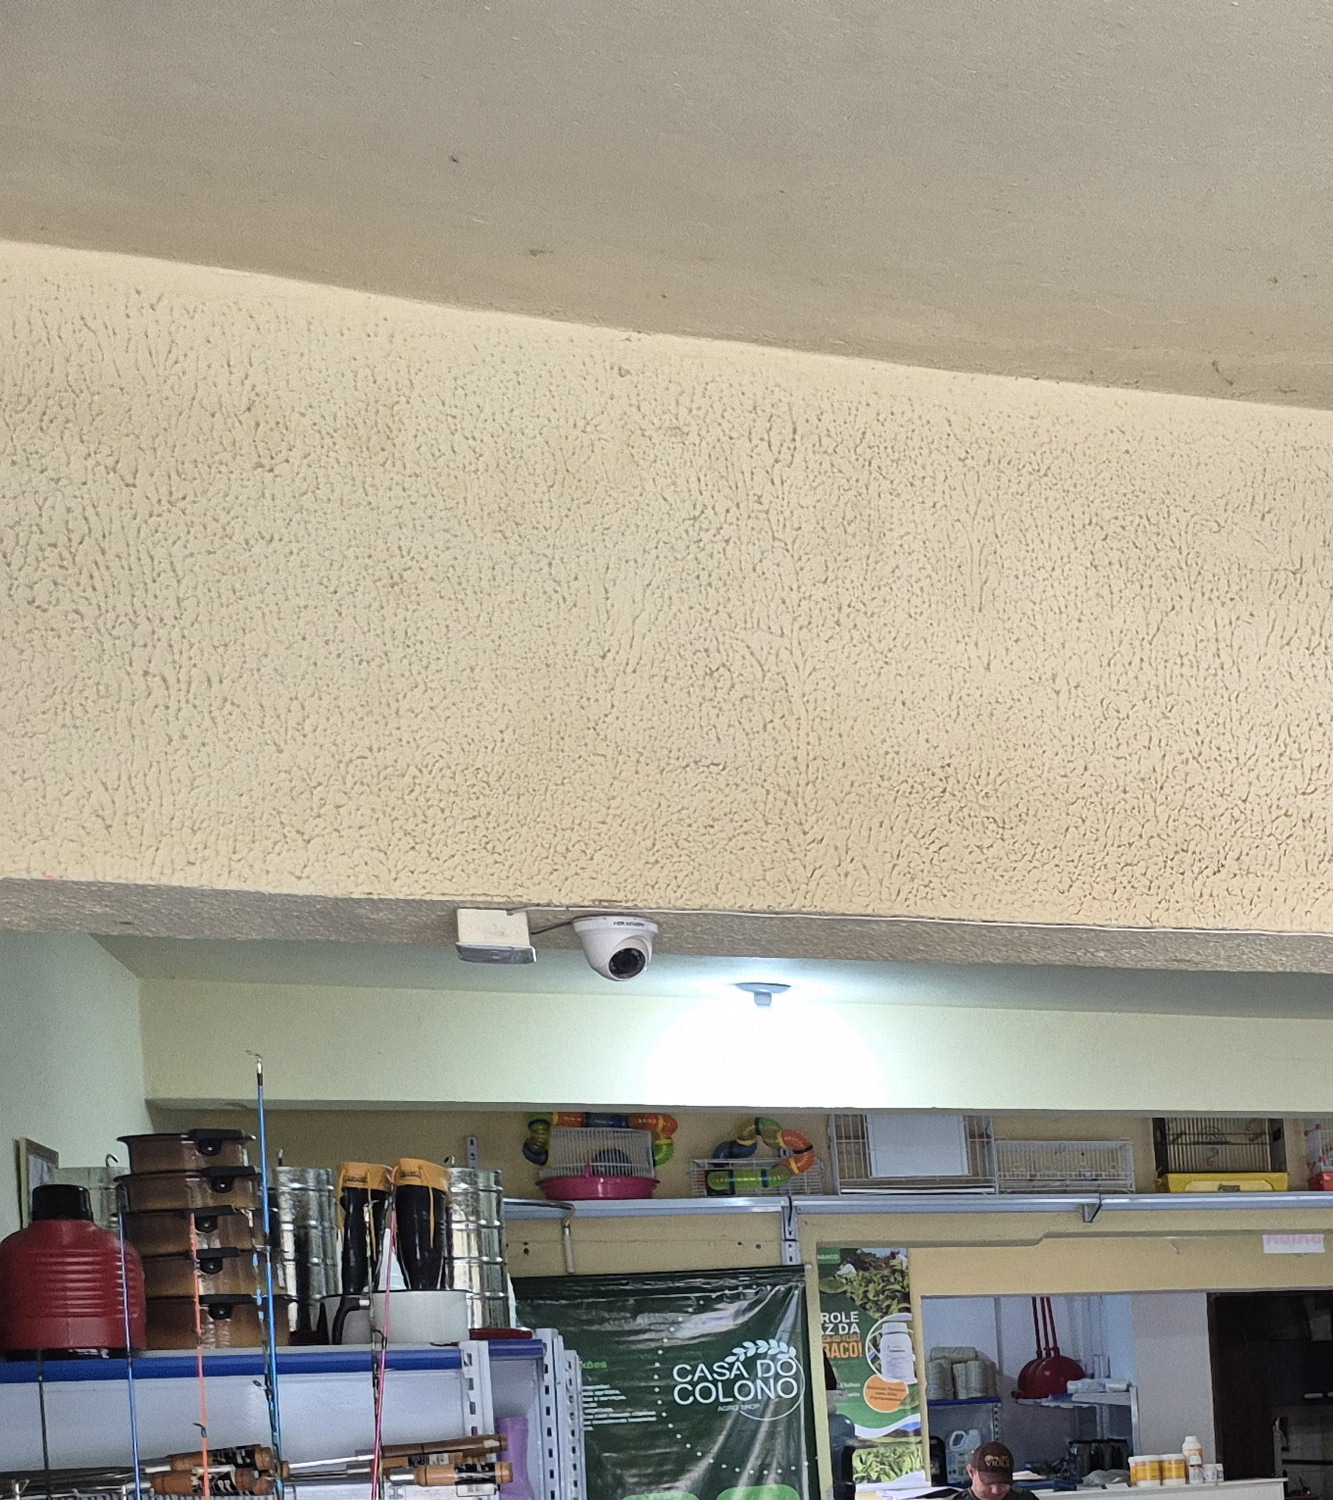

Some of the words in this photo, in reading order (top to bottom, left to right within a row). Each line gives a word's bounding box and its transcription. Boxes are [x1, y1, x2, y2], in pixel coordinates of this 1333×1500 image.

[838, 1322, 861, 1335] DA
[672, 1361, 750, 1383] CASA
[756, 1357, 798, 1379] DO
[673, 1376, 799, 1406] COLONO
